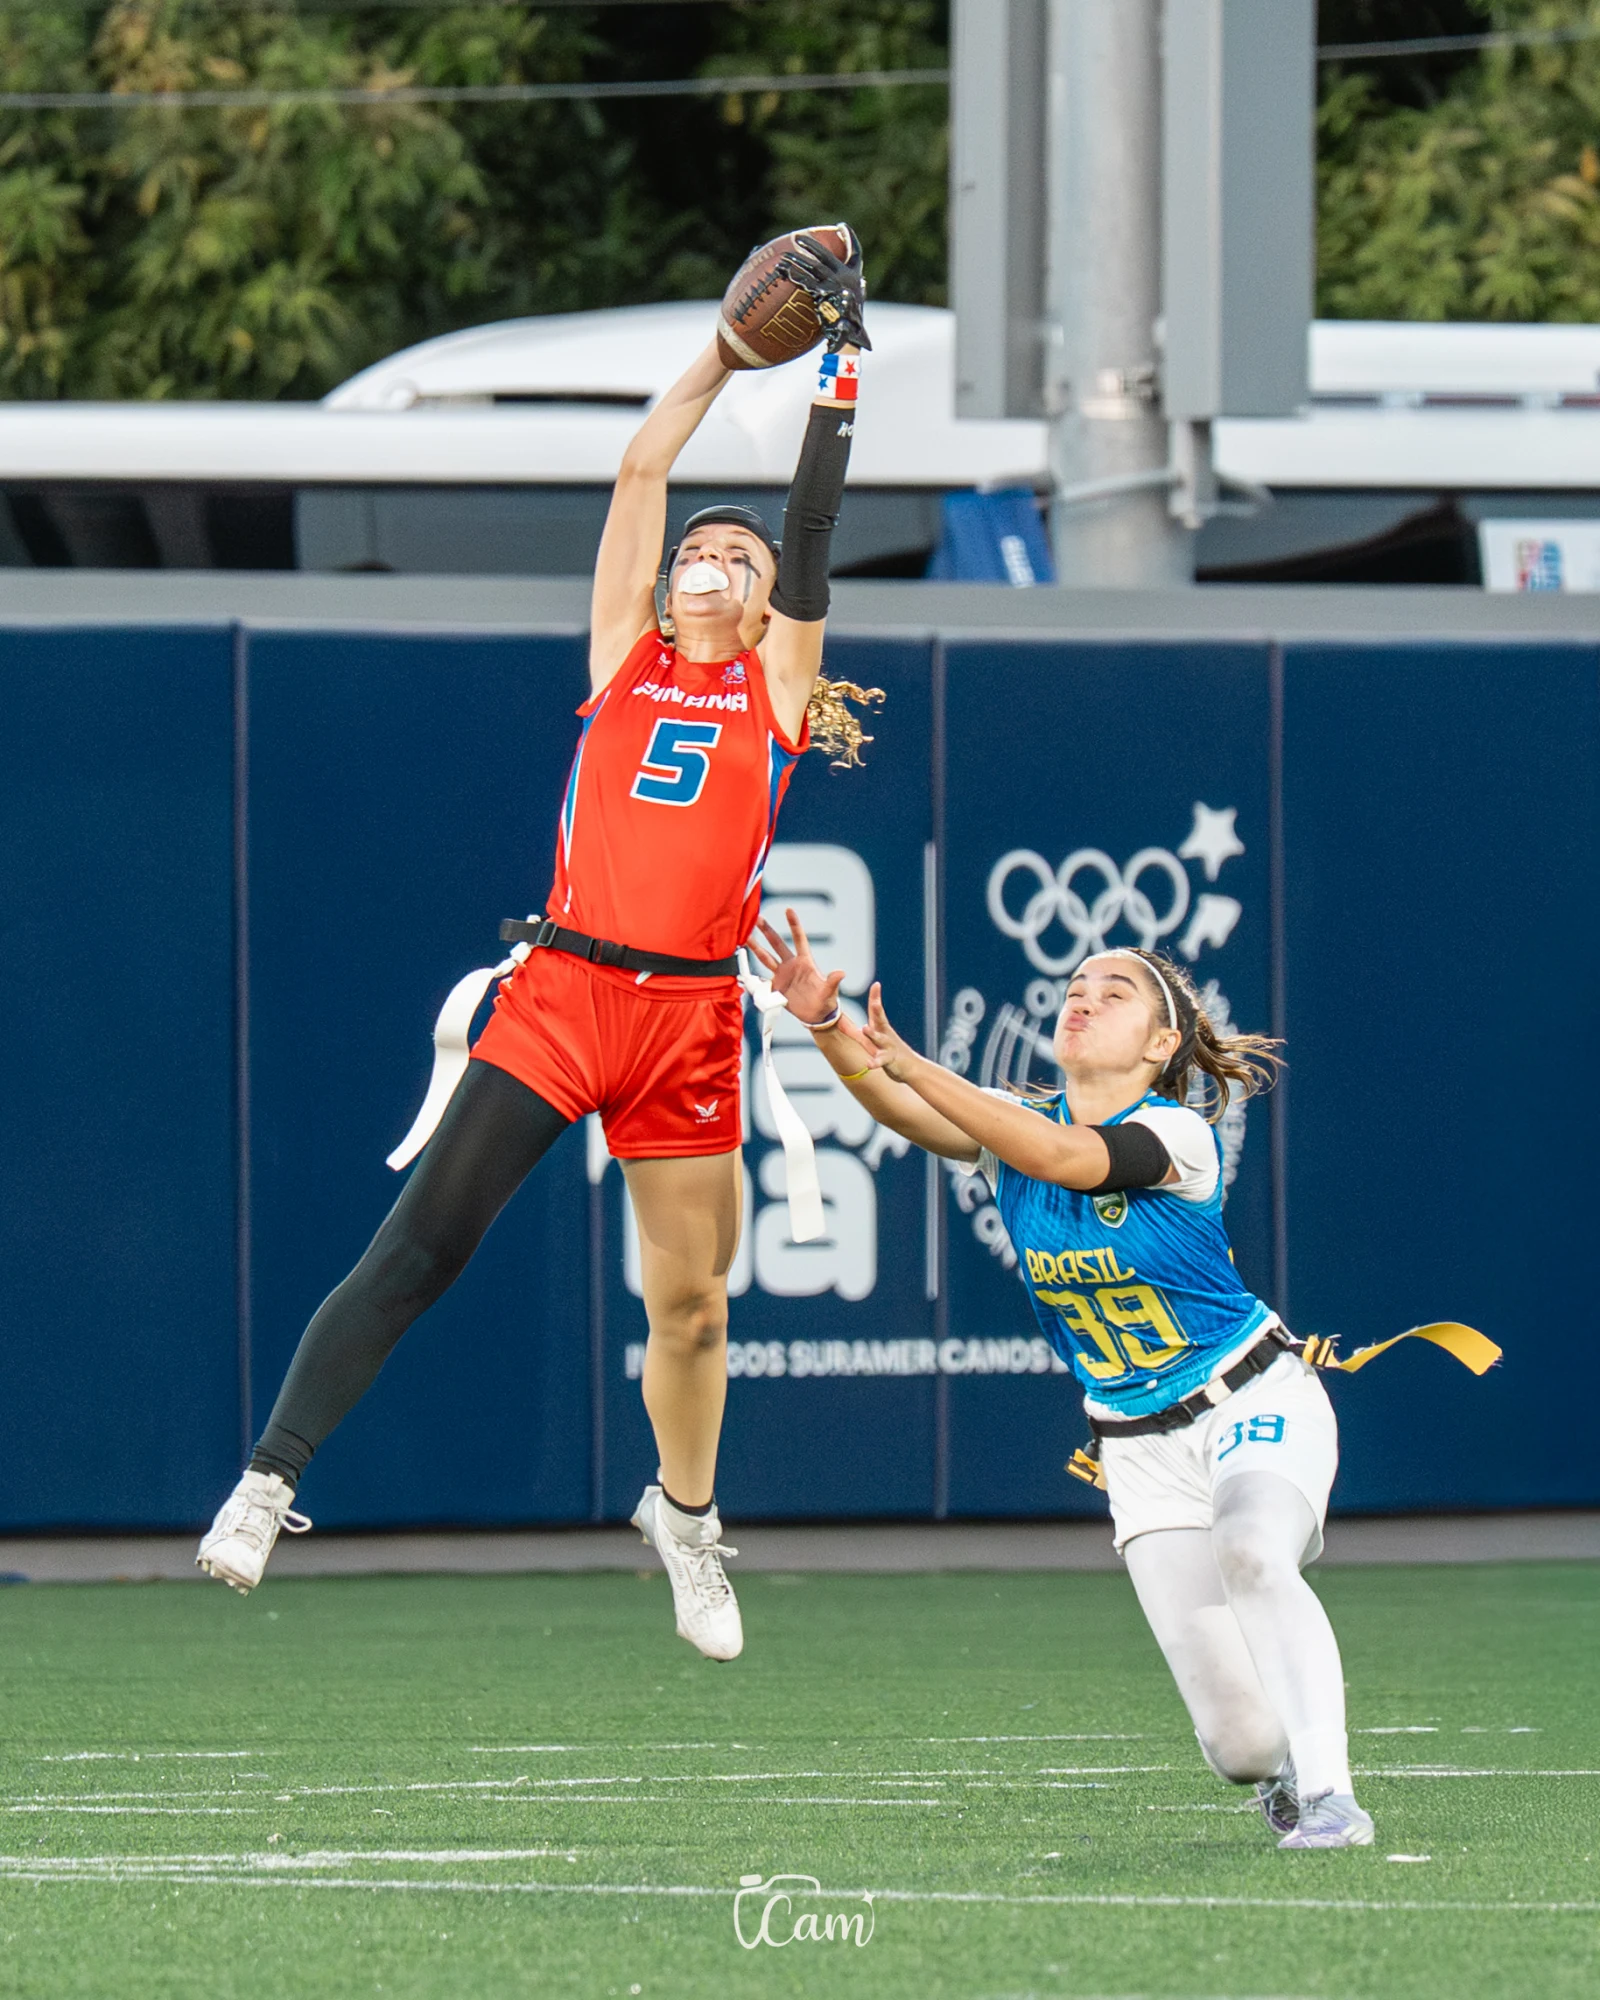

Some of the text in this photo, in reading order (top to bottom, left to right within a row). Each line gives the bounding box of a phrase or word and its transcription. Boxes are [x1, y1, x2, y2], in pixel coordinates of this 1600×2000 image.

[629, 717, 723, 807] 5
[1025, 1246, 1136, 1285] BRASIL
[1035, 1284, 1195, 1385] 39
[1217, 1414, 1287, 1462] 39
